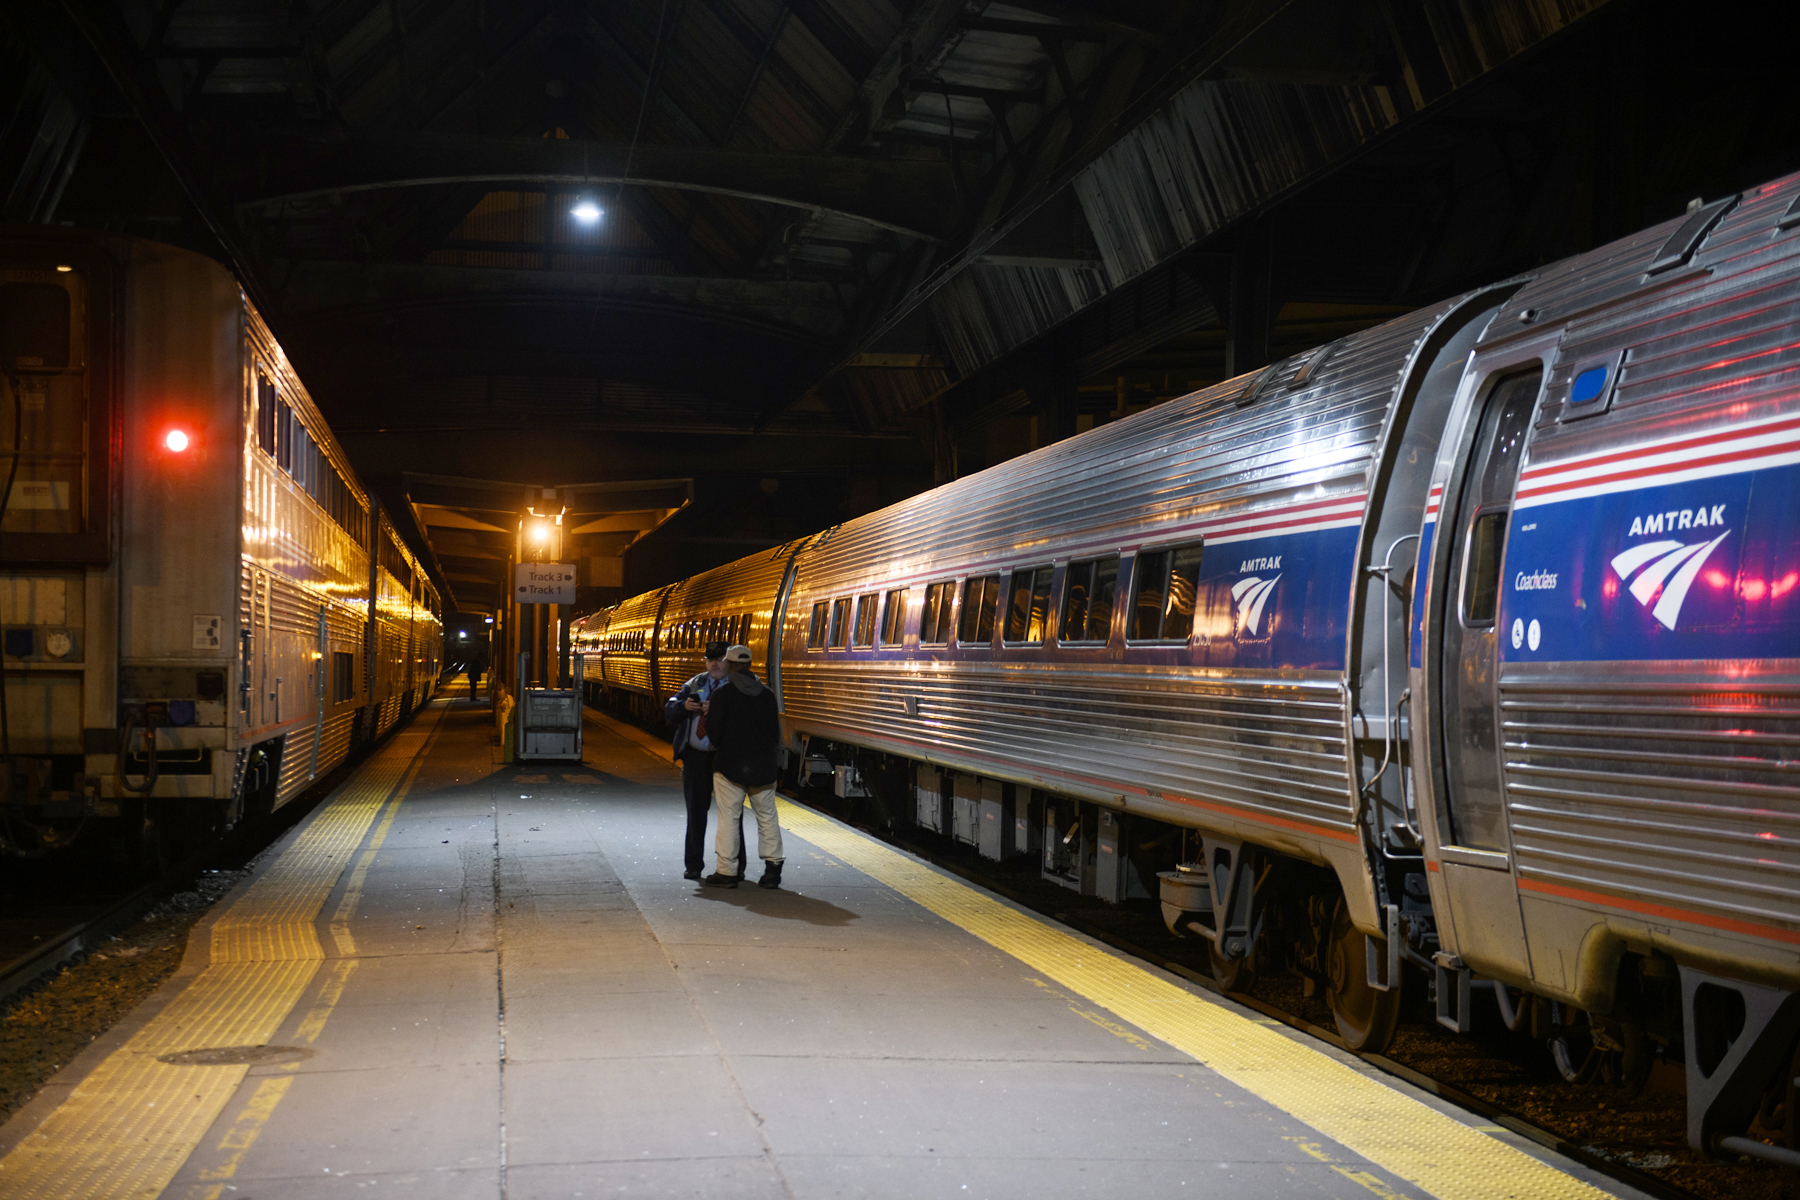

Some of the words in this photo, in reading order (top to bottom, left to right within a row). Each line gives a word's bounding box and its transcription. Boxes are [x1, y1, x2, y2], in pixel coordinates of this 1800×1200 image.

[1628, 504, 1726, 537] AMTRAK
[1239, 555, 1282, 573] AMTRAK
[529, 572, 554, 581] Track
[556, 573, 563, 581] 3
[1515, 569, 1558, 591] Coachclass
[528, 585, 554, 594] Track
[557, 586, 562, 595] 1
